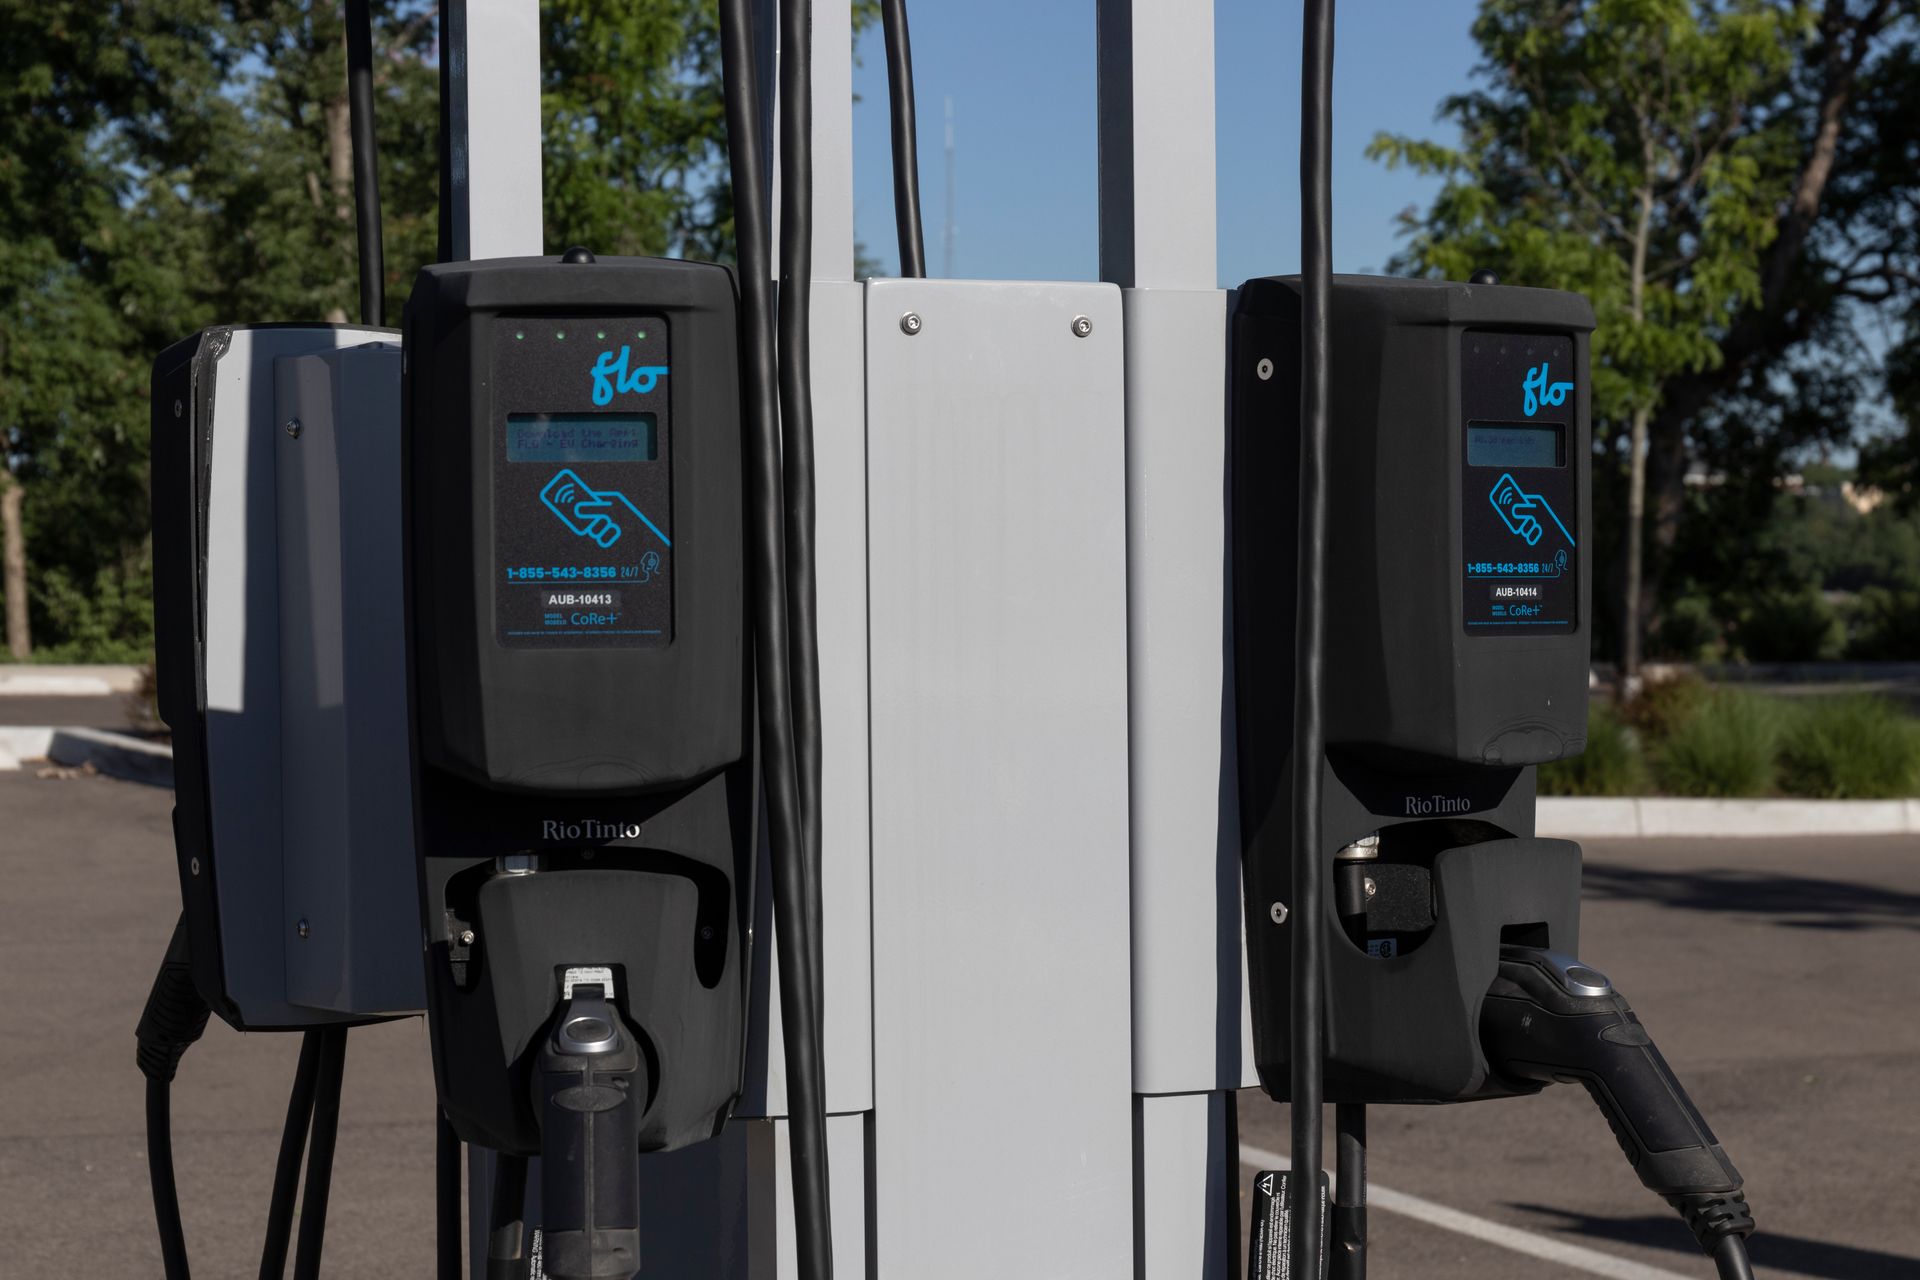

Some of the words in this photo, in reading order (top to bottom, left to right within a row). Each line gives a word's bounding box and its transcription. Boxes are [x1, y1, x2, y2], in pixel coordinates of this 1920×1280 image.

[590, 344, 669, 407] flo
[1522, 362, 1574, 417] flo
[507, 567, 617, 579] 1-855-543-8356
[620, 565, 640, 578] 24/7
[1467, 563, 1540, 574] 1-855-543-8356
[1541, 563, 1554, 574] 24/7
[1495, 587, 1538, 597] AUB-10414
[548, 594, 613, 605] AUB-10413
